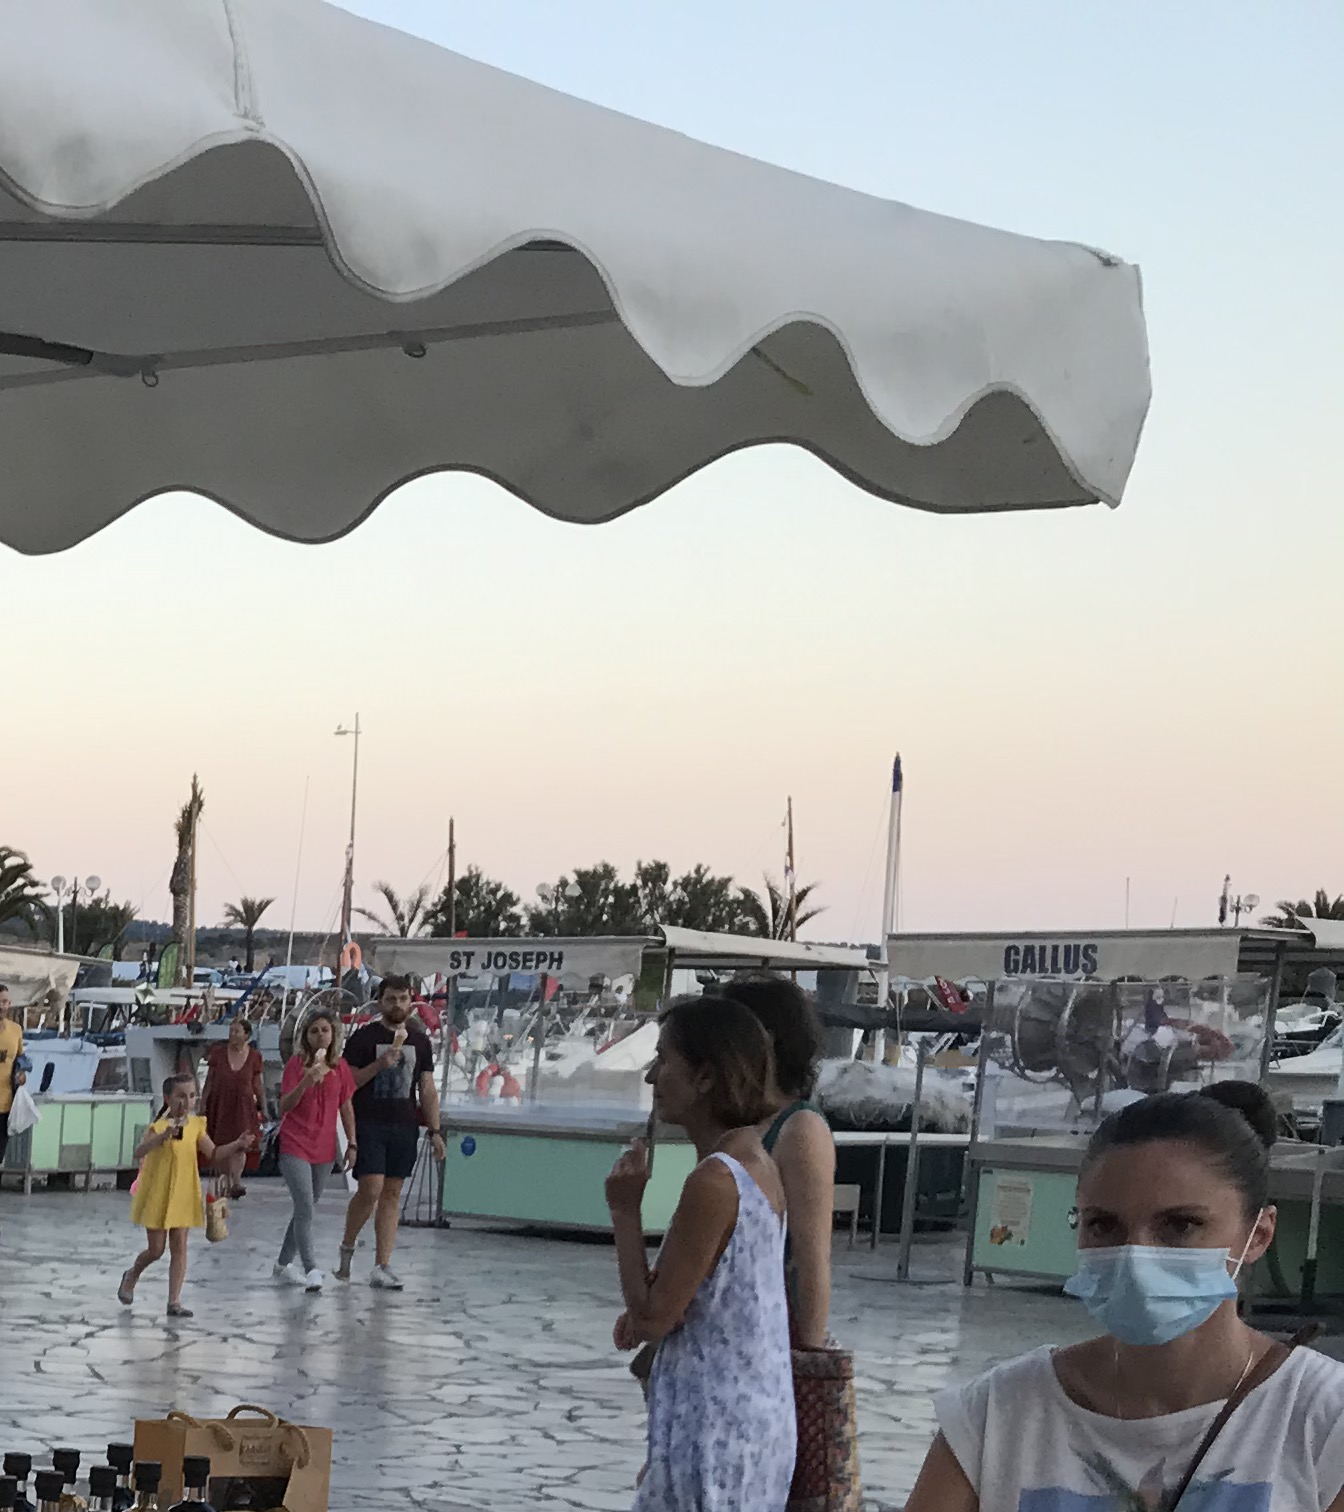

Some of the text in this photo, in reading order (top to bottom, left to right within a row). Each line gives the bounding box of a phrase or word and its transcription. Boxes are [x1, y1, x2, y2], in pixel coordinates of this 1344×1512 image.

[449, 950, 564, 970] ST JOSEPH
[1003, 943, 1098, 975] GALLUS
